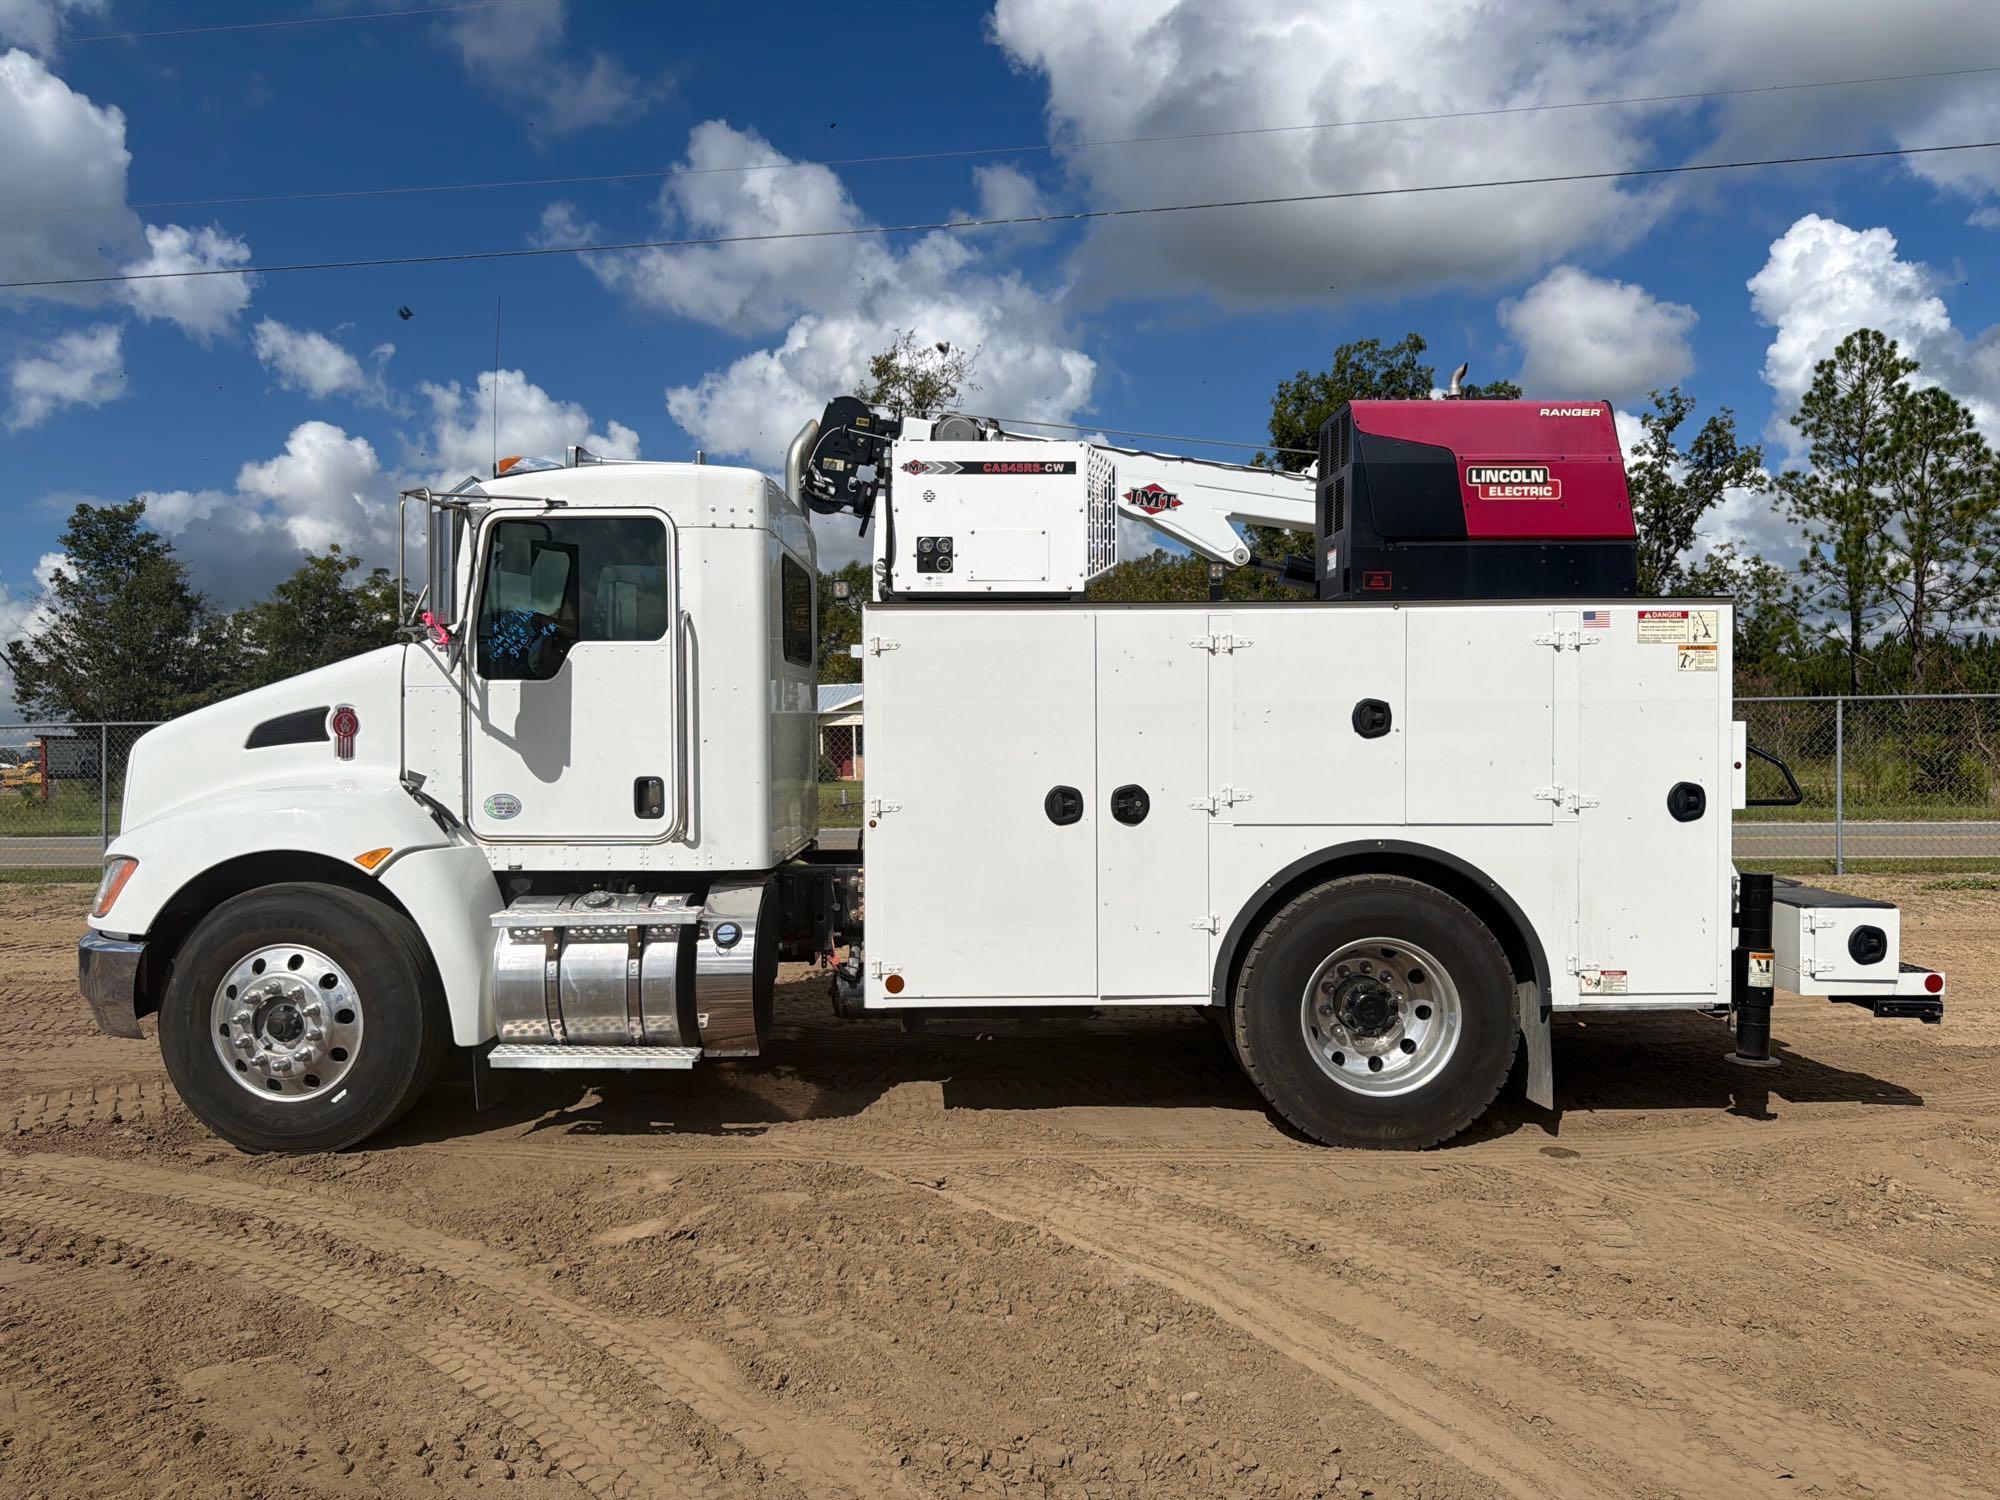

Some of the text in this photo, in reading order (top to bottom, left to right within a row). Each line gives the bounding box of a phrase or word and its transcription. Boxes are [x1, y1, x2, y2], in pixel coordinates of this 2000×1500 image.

[1539, 408, 1601, 417] RANGER
[903, 463, 927, 472] IMT
[1471, 469, 1544, 483] LINCOLN
[1488, 486, 1552, 496] ELECTRIC
[1129, 487, 1178, 511] IMT
